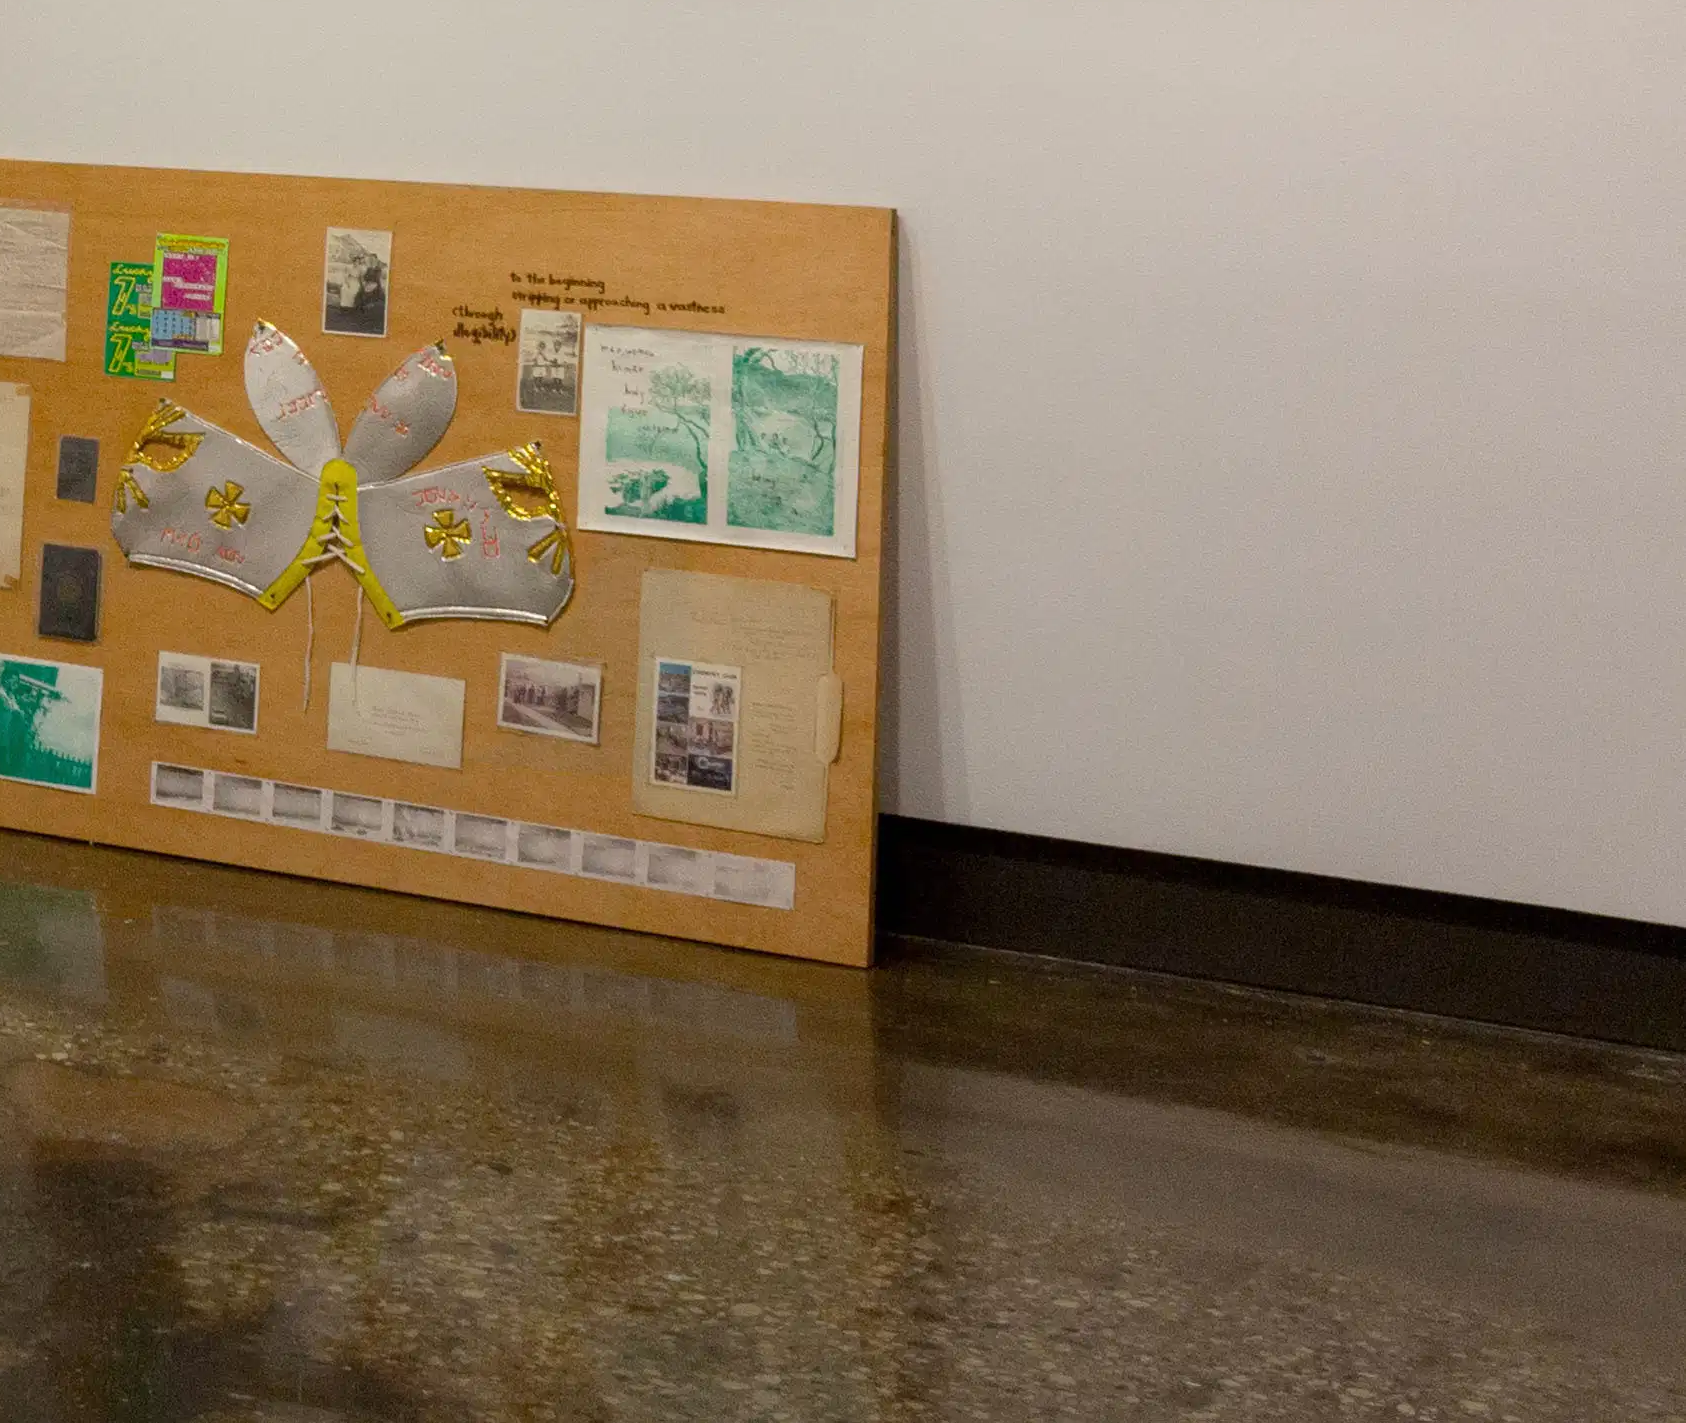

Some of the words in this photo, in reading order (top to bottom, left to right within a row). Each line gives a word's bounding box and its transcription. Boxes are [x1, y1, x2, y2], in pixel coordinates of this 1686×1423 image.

[510, 272, 521, 282] to
[527, 273, 545, 284] the
[549, 274, 605, 294] beginning
[579, 295, 650, 315] approaching
[668, 300, 725, 314] vastness
